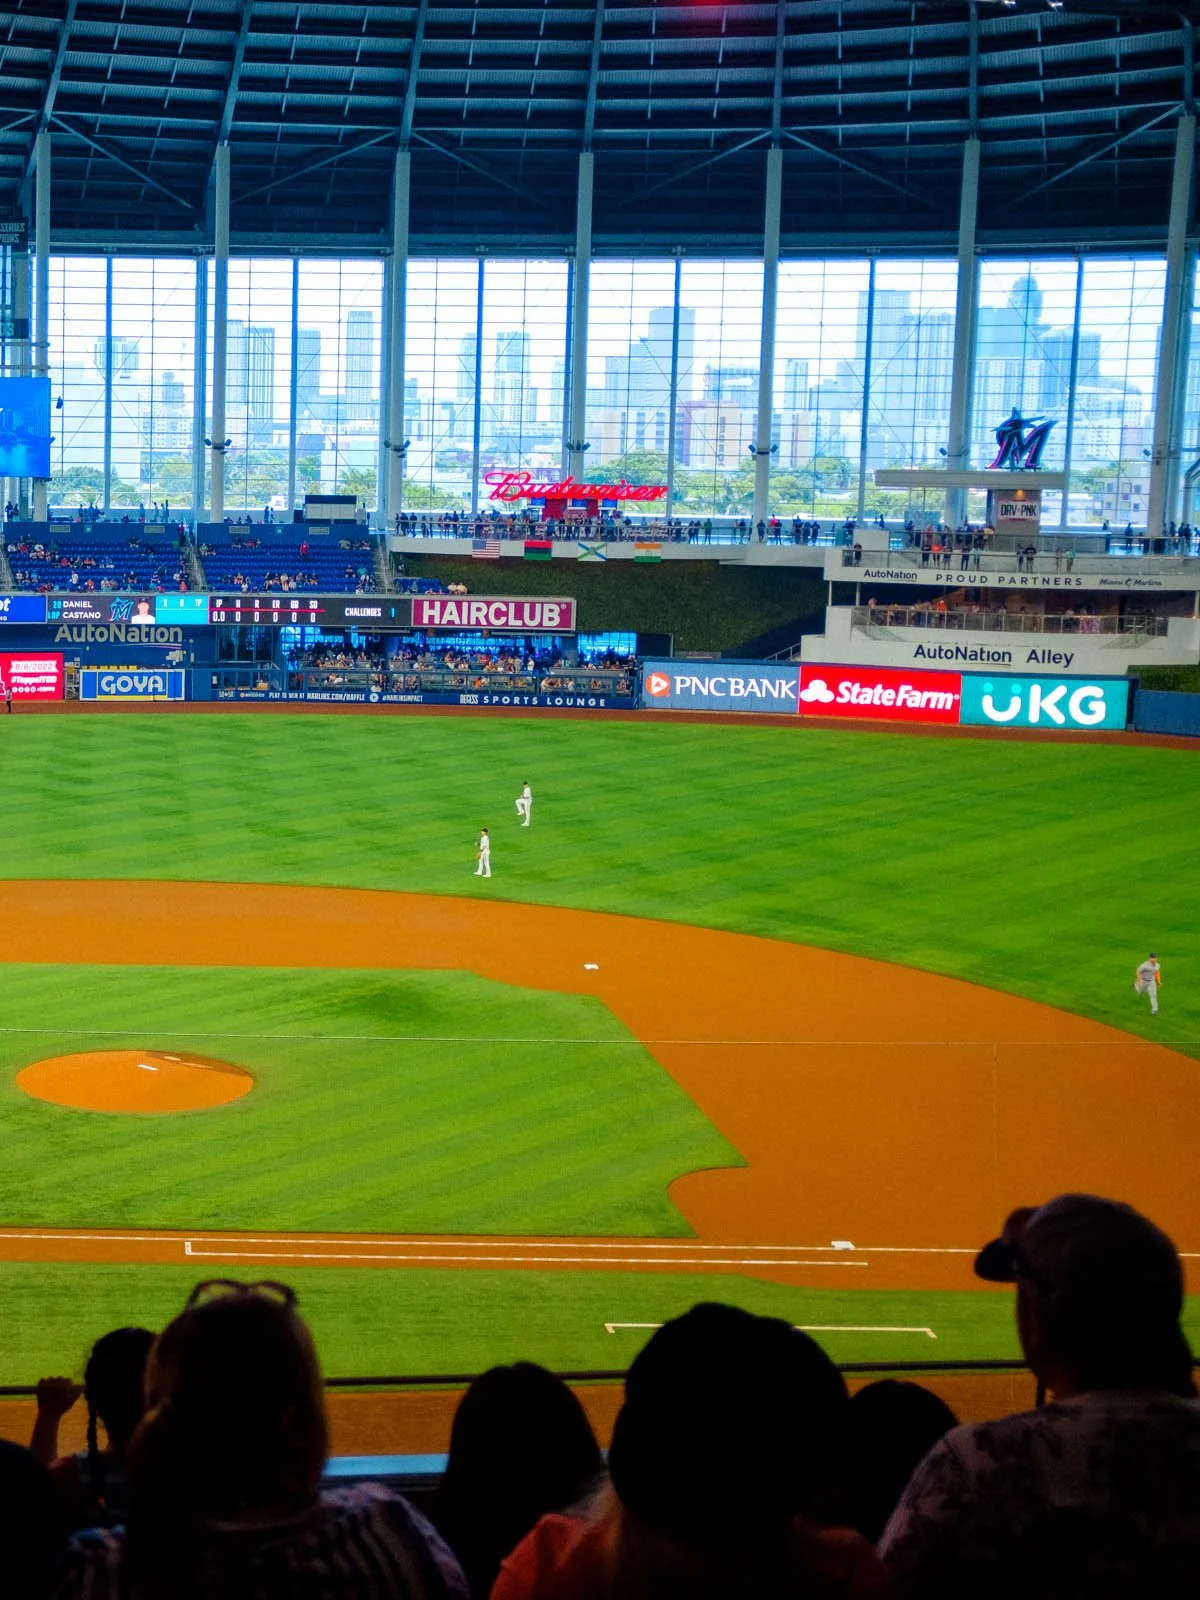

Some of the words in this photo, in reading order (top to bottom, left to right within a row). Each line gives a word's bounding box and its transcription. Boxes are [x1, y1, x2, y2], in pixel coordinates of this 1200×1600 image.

[0, 222, 25, 232] SERIES
[484, 472, 669, 502] Budweiser
[864, 569, 918, 580] AutoNation
[936, 574, 988, 584] PROUD
[998, 576, 1083, 586] PARTNERS
[63, 611, 101, 619] CASTANO
[345, 607, 382, 617] CHALLENGES
[423, 601, 560, 627] HAIRCLUB
[55, 623, 183, 643] AutoNation
[914, 644, 1012, 663] AutoNation
[1026, 649, 1075, 668] Alley
[101, 675, 163, 694] GOYA
[674, 676, 726, 697] PNC
[728, 677, 796, 699] BANK
[483, 695, 538, 705] SPORTS
[546, 697, 606, 707] LOUNGE
